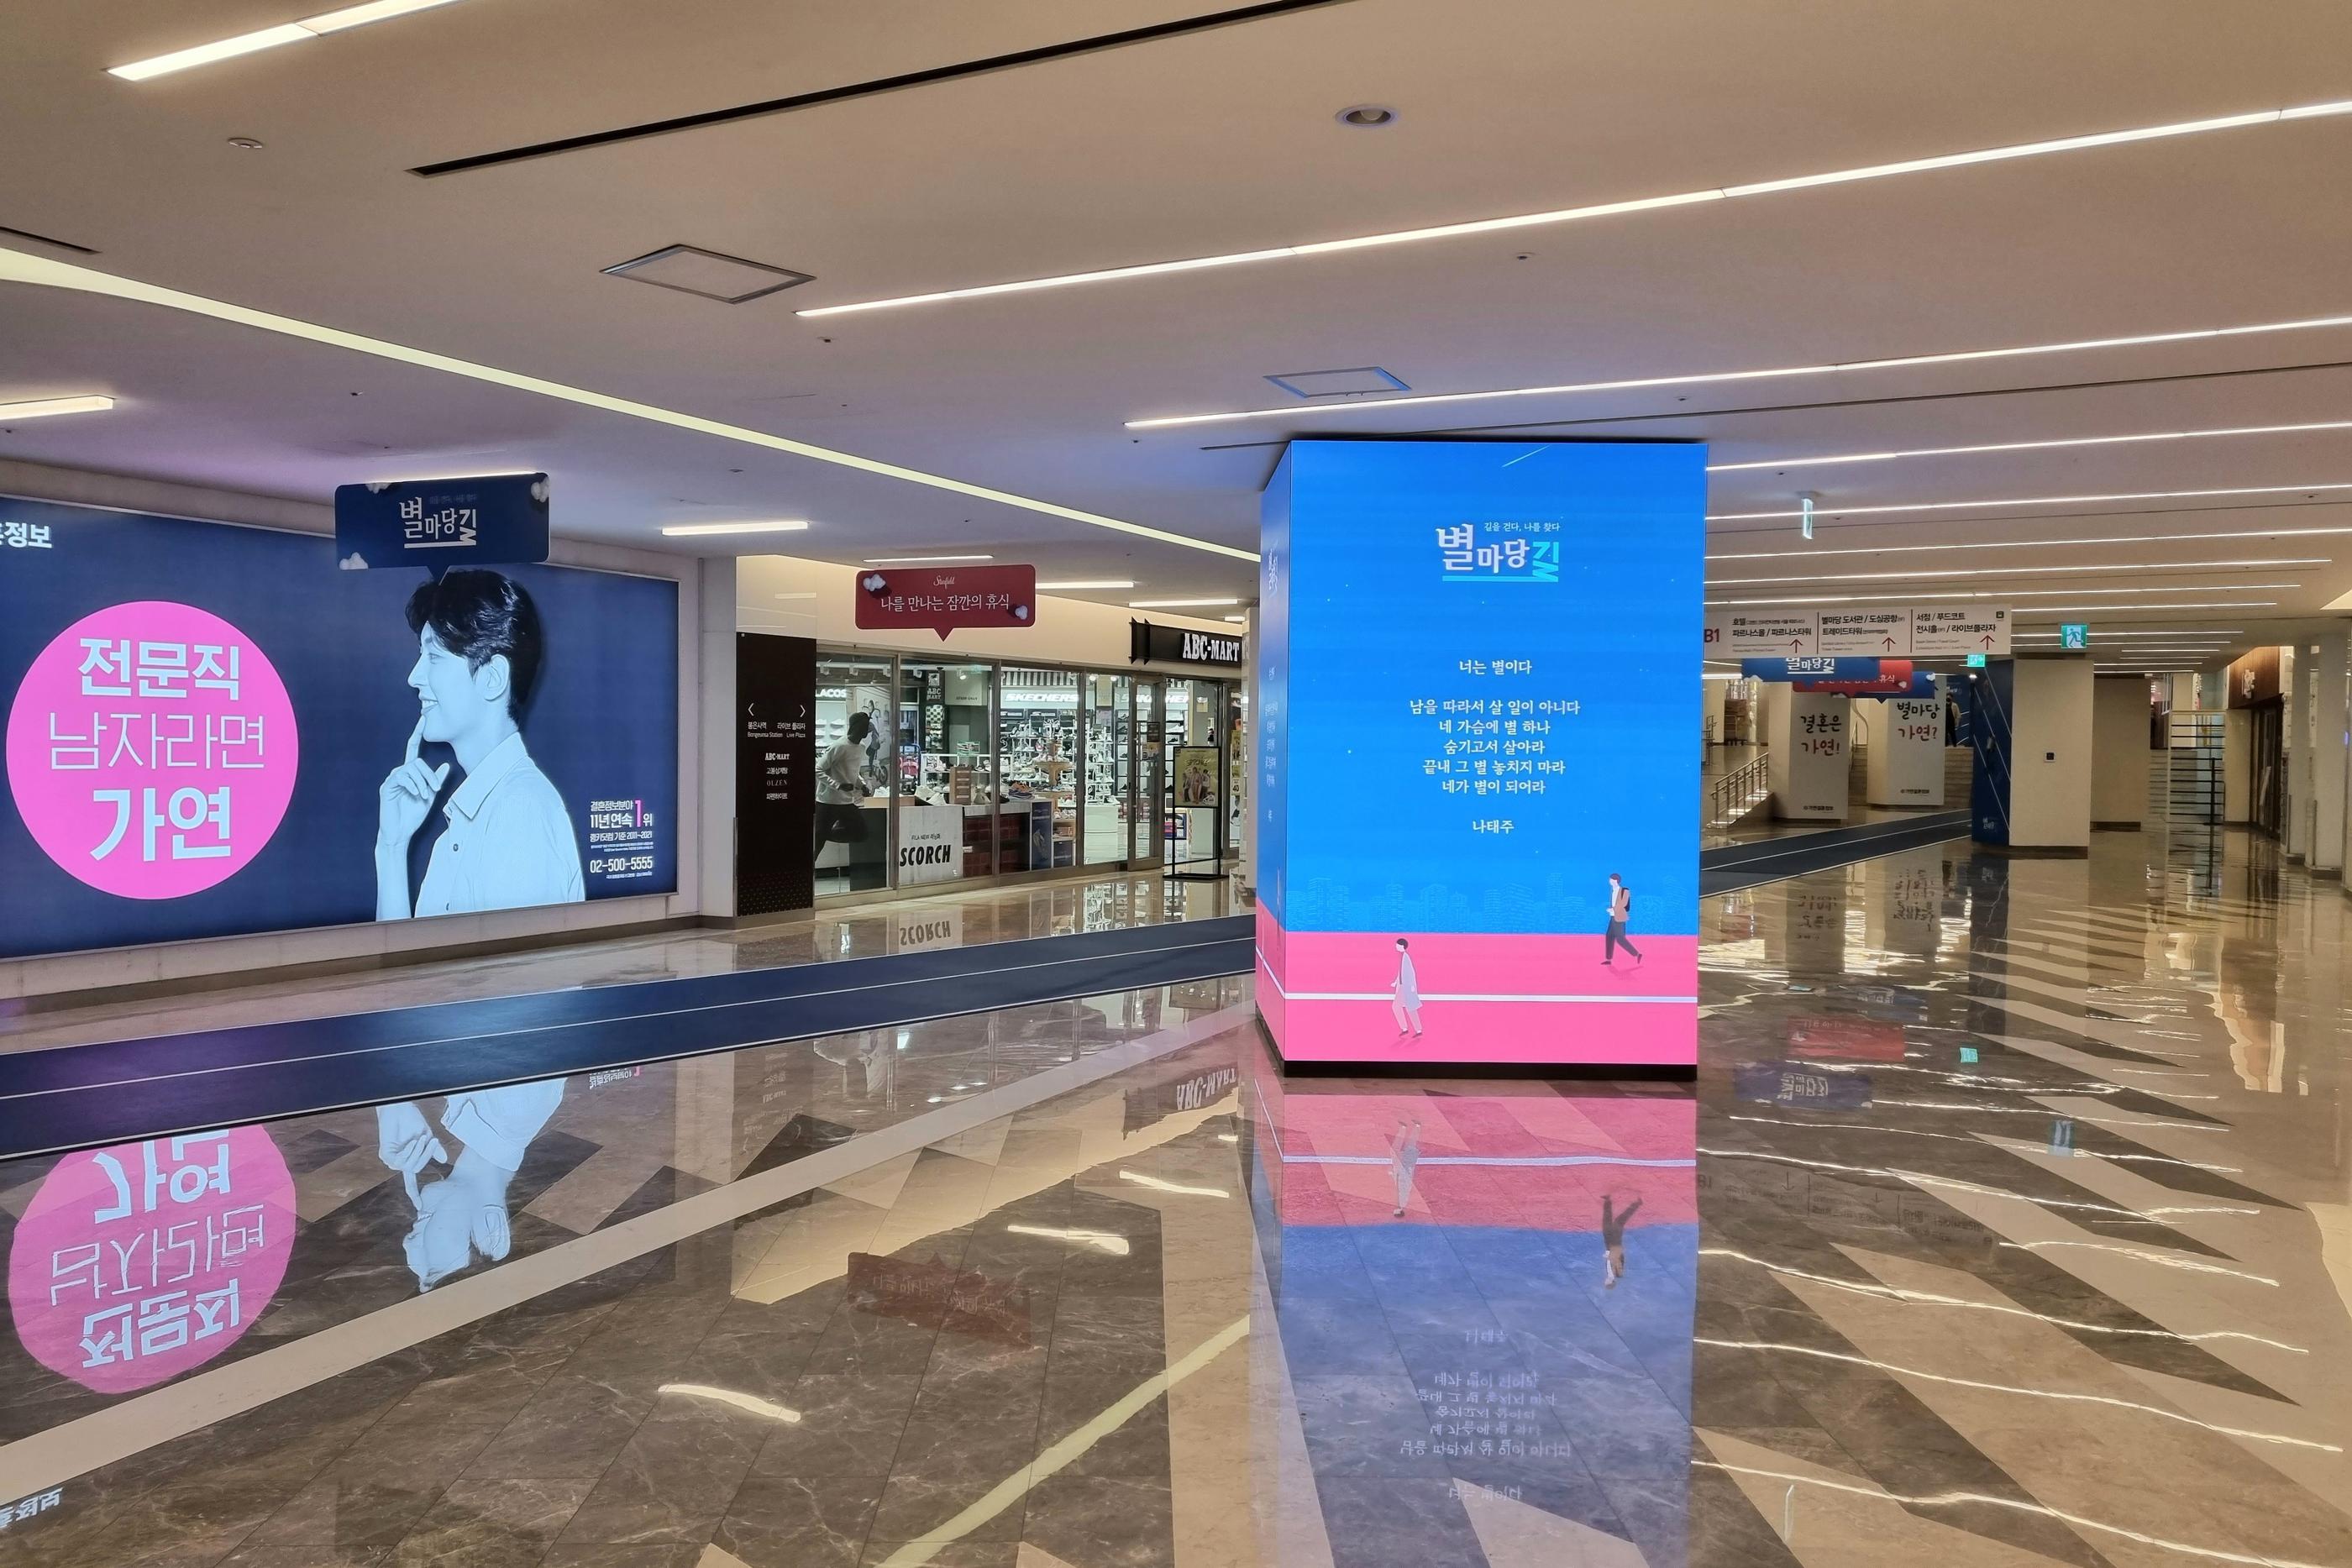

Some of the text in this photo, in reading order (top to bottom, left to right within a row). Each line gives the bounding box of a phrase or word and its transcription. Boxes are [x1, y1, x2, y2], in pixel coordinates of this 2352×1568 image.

[0, 522, 53, 548] 정보
[1484, 522, 1500, 532] 길을
[1524, 522, 1541, 532] 나를
[1543, 522, 1561, 532] 찾다
[881, 593, 1010, 612] 나를 만나는 잠깐의 휴식
[1821, 616, 1841, 625] 별마당
[1843, 616, 1863, 624] 도서관
[1704, 628, 1720, 642] B1
[1823, 627, 1862, 636] 트레이드타워
[1182, 632, 1240, 662] ABC-MART
[78, 638, 239, 700] 전문직
[1459, 659, 1532, 675] 너는 별이다
[1005, 693, 1079, 702] SKECHERS
[1410, 699, 1581, 716] 남을 따라서 살 일이 아니다
[1897, 701, 1940, 720] 별마당
[1439, 720, 1551, 735] 네 가슴에 별 하나
[1801, 713, 1842, 734] 결혼은
[50, 712, 264, 769] 남자라면
[1898, 724, 1938, 742] 가연?
[1444, 739, 1546, 755] 숨기고서 살아라
[1801, 738, 1840, 756] 가연!
[1423, 759, 1566, 775] 끝내 그 별 놓치지 마라
[1441, 779, 1546, 794] 네가 별이 되어라
[90, 786, 231, 862] 가연
[1473, 820, 1515, 835] 나태주
[900, 844, 951, 867] SCORCH
[590, 856, 653, 873] 02-500-5555
